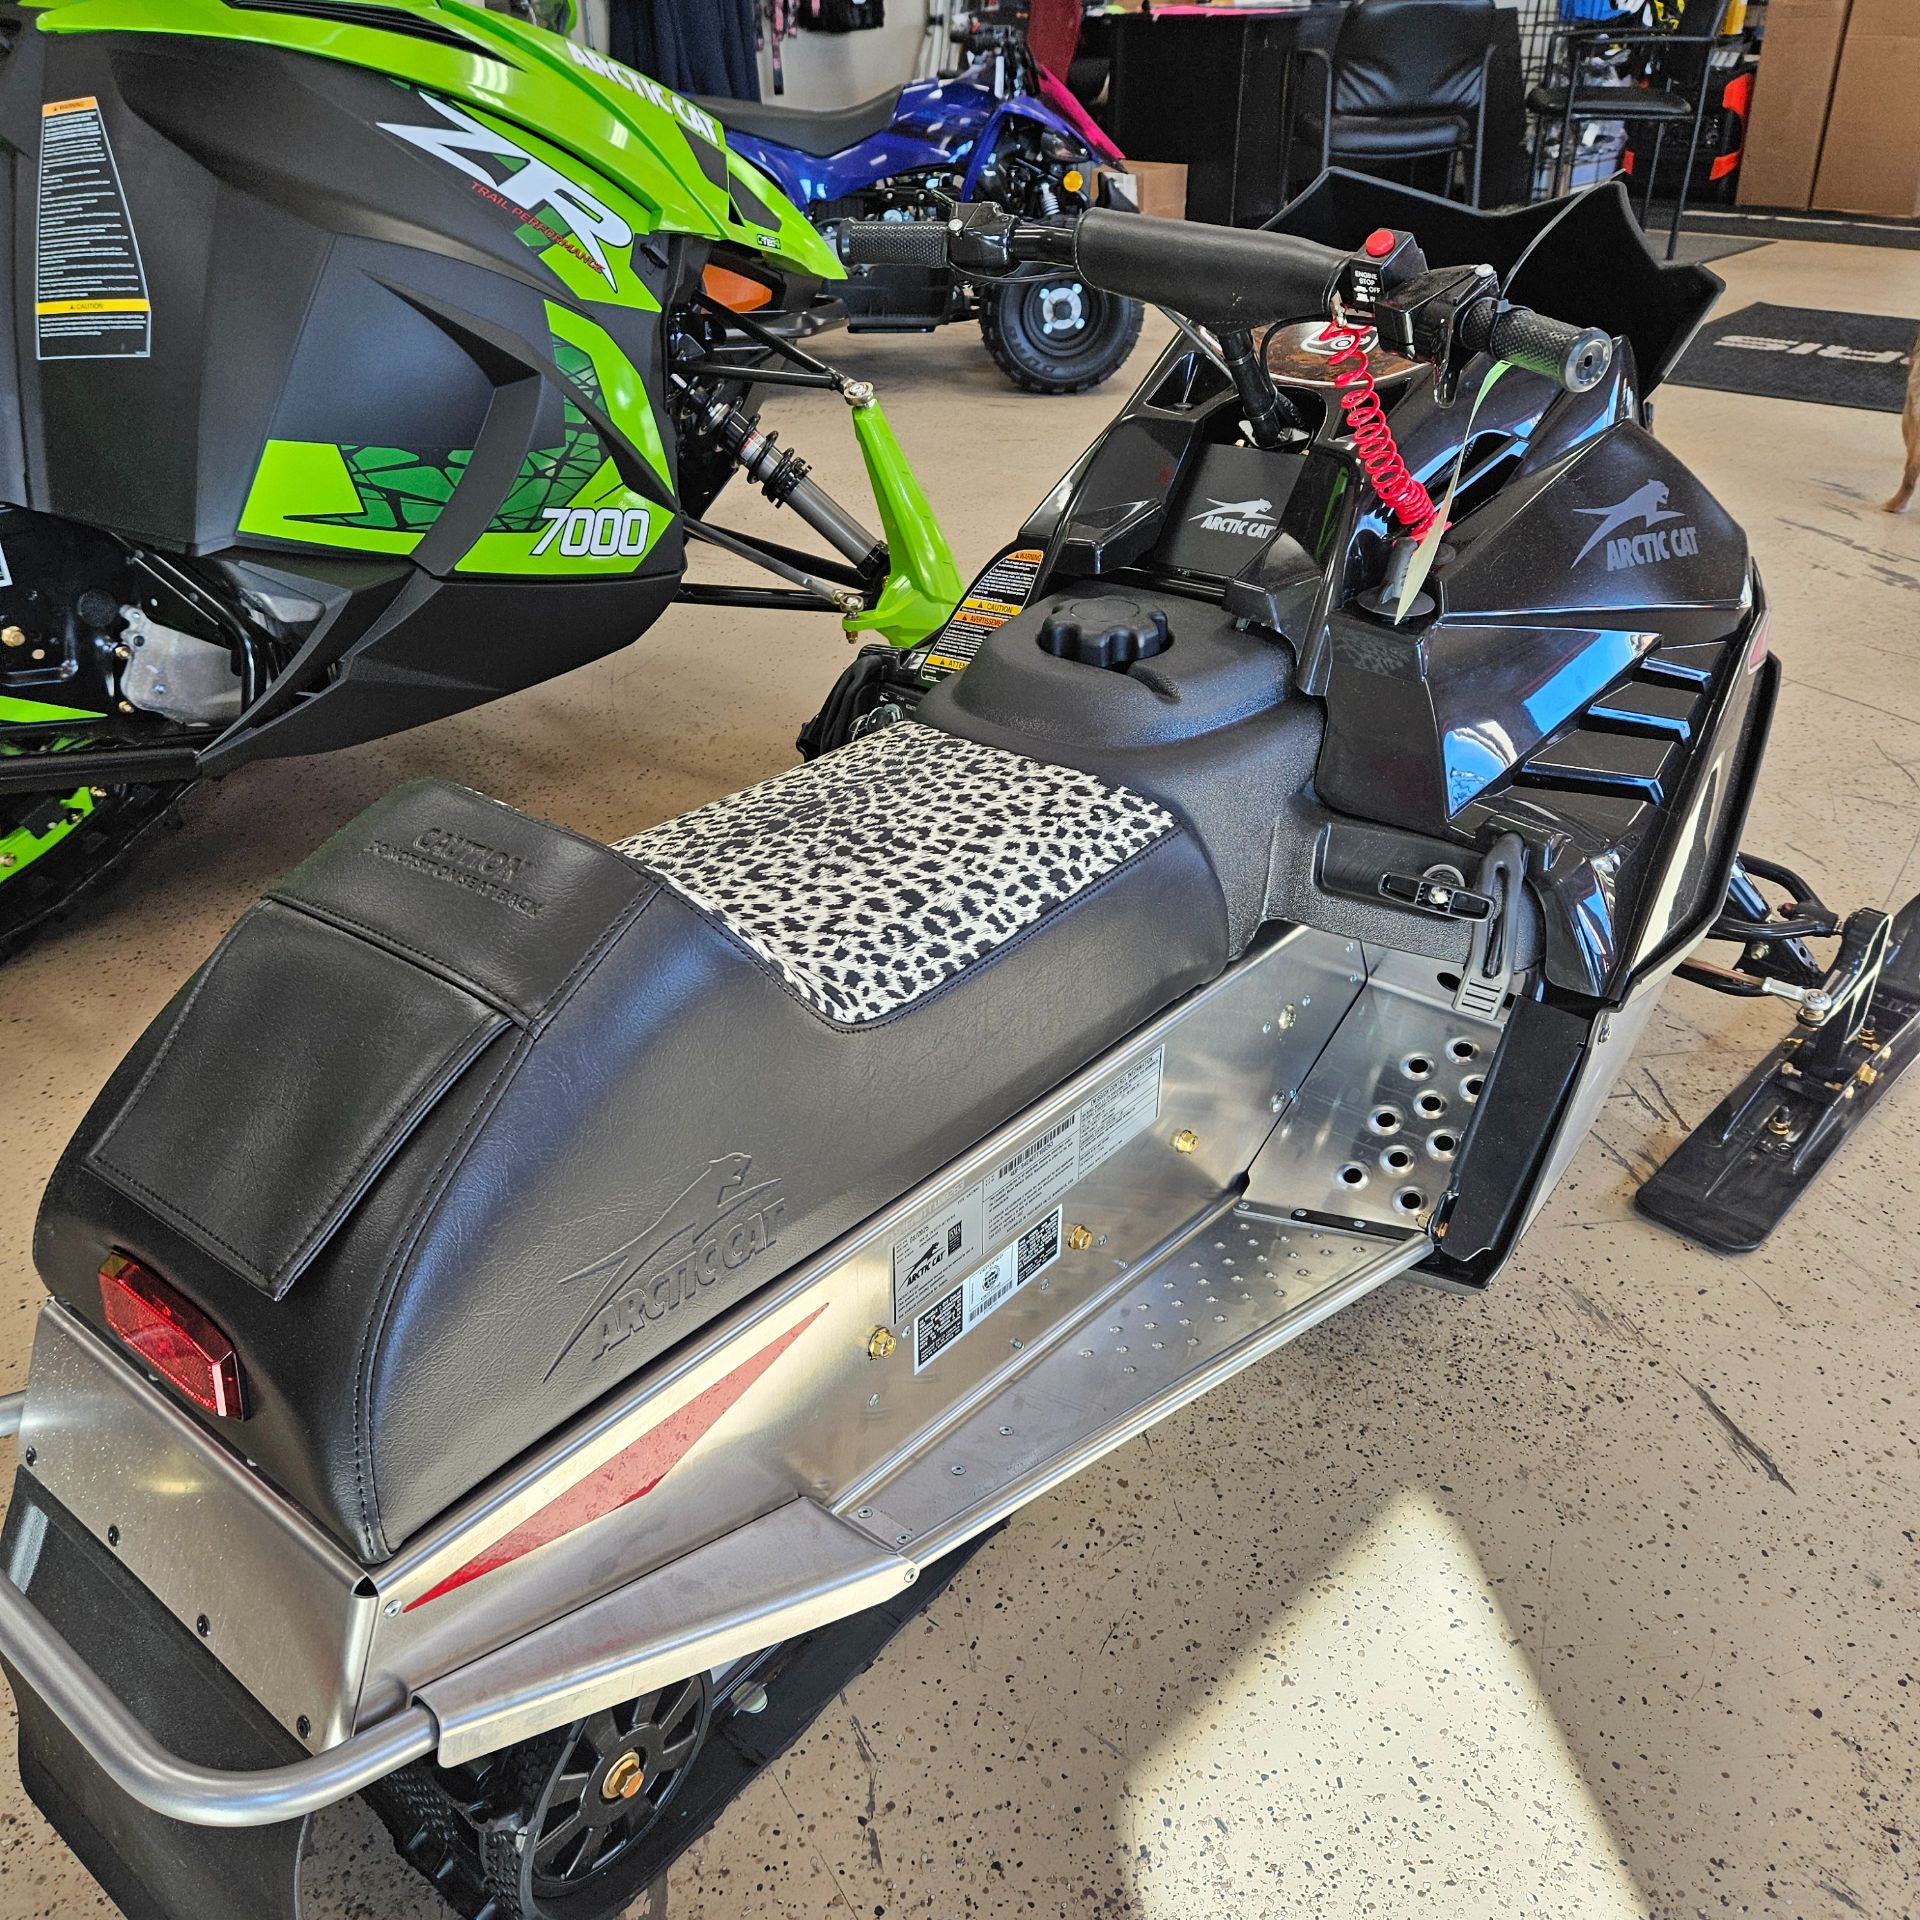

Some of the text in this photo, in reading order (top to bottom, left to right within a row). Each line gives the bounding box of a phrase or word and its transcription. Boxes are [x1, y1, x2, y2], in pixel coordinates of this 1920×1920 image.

[565, 38, 719, 146] ARCTIC CAT
[375, 91, 634, 294] ZR
[470, 180, 606, 274] TRAIL PERFORMANCE
[1354, 270, 1378, 281] ENGINE
[1358, 278, 1376, 286] STOP
[1368, 286, 1381, 294] OFF
[528, 506, 651, 557] 7000
[1200, 515, 1277, 539] ARCTIC CAT
[1606, 526, 1699, 572] ARCTIC CAT
[986, 602, 1013, 614] CAUTION
[413, 827, 528, 882] CAUTION
[454, 872, 499, 897] SEAT
[493, 888, 549, 920] BACK
[592, 1238, 717, 1361] ARCTIC
[722, 1197, 785, 1269] CAT
[906, 1261, 931, 1287] ARCTIC
[931, 1250, 946, 1267] CAT
